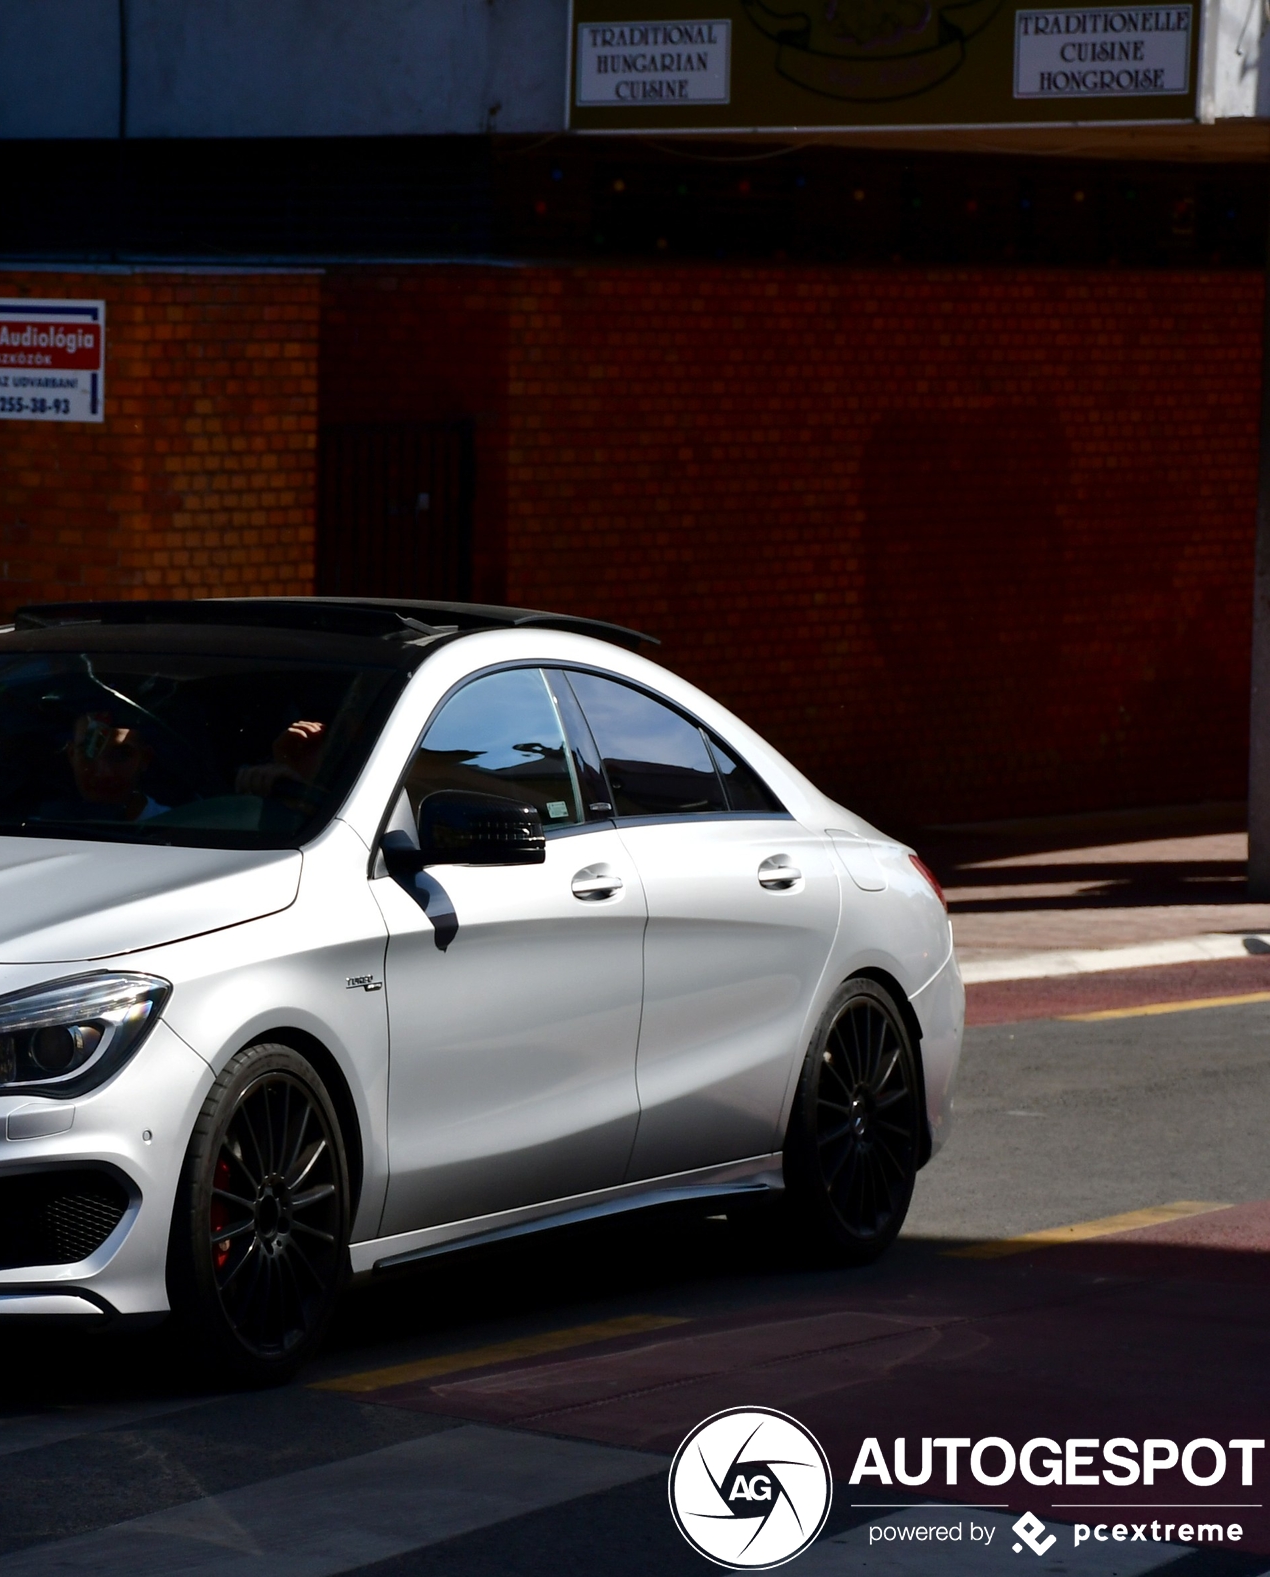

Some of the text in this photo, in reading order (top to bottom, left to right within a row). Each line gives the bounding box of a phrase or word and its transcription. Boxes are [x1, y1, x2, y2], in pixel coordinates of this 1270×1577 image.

[1019, 11, 1189, 36] TRADITIONELLE
[590, 25, 717, 48] TRADITIONAL
[597, 52, 709, 74] HUNGARIAN
[1059, 40, 1145, 63] CUISINE
[614, 79, 689, 100] CUISINE
[1039, 69, 1165, 92] HONGROISE
